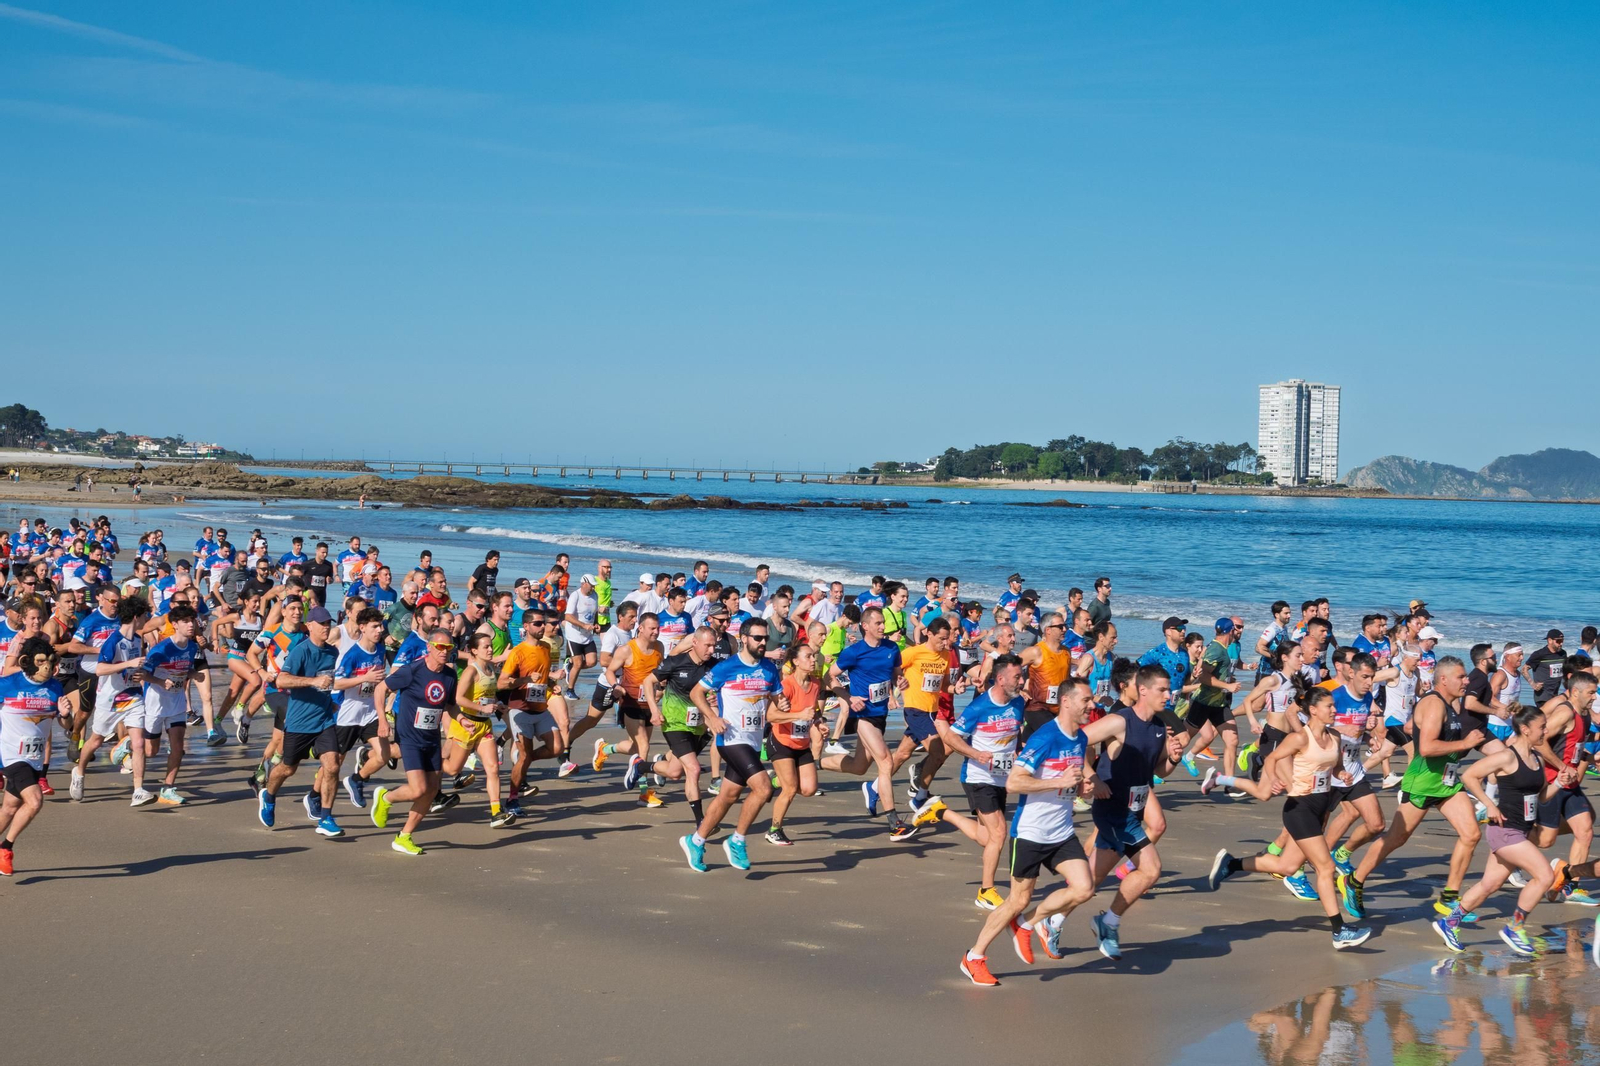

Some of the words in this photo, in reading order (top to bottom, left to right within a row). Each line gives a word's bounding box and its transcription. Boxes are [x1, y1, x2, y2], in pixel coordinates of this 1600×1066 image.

[874, 687, 887, 697] 181
[423, 714, 436, 724] 52
[994, 760, 1012, 769] 213
